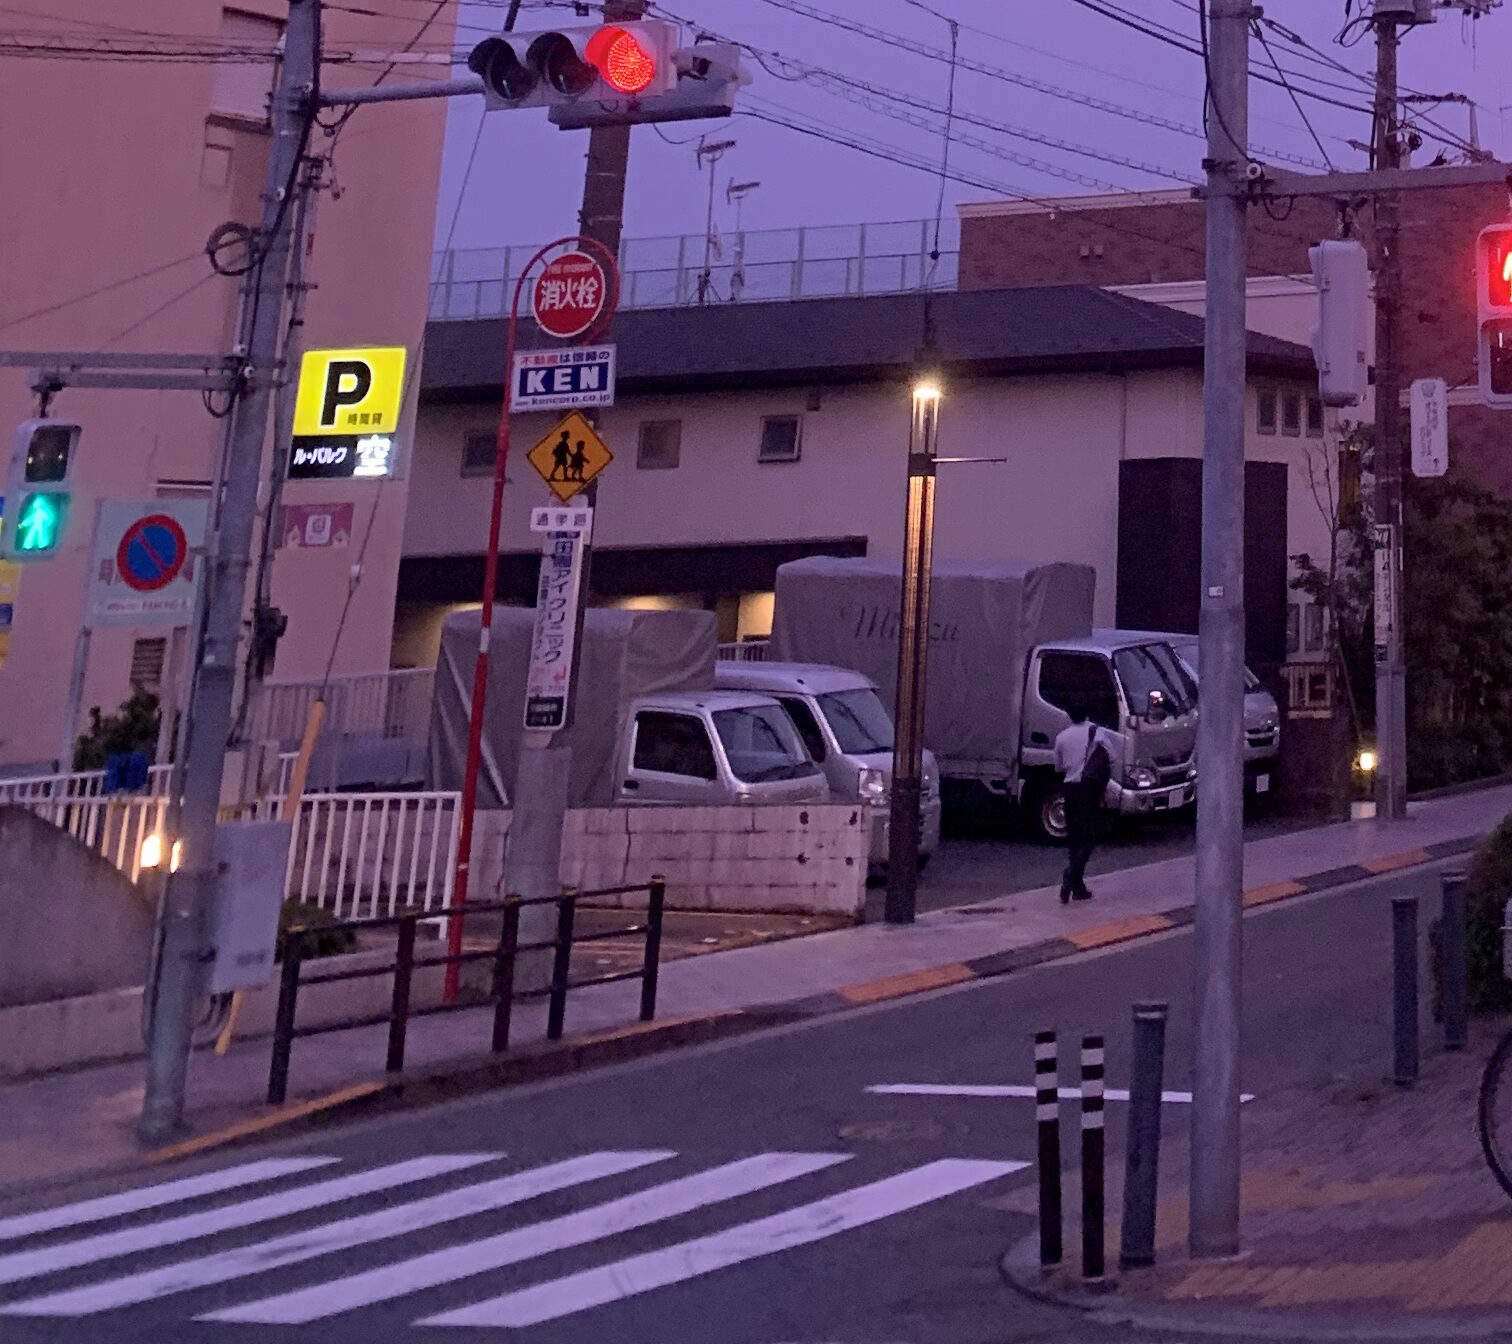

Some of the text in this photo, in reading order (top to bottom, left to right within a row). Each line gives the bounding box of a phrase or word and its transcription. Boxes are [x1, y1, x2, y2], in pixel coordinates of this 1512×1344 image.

[539, 276, 600, 312] 消火栓
[320, 361, 372, 425] P
[526, 366, 601, 394] KEN
[353, 434, 392, 476] 空
